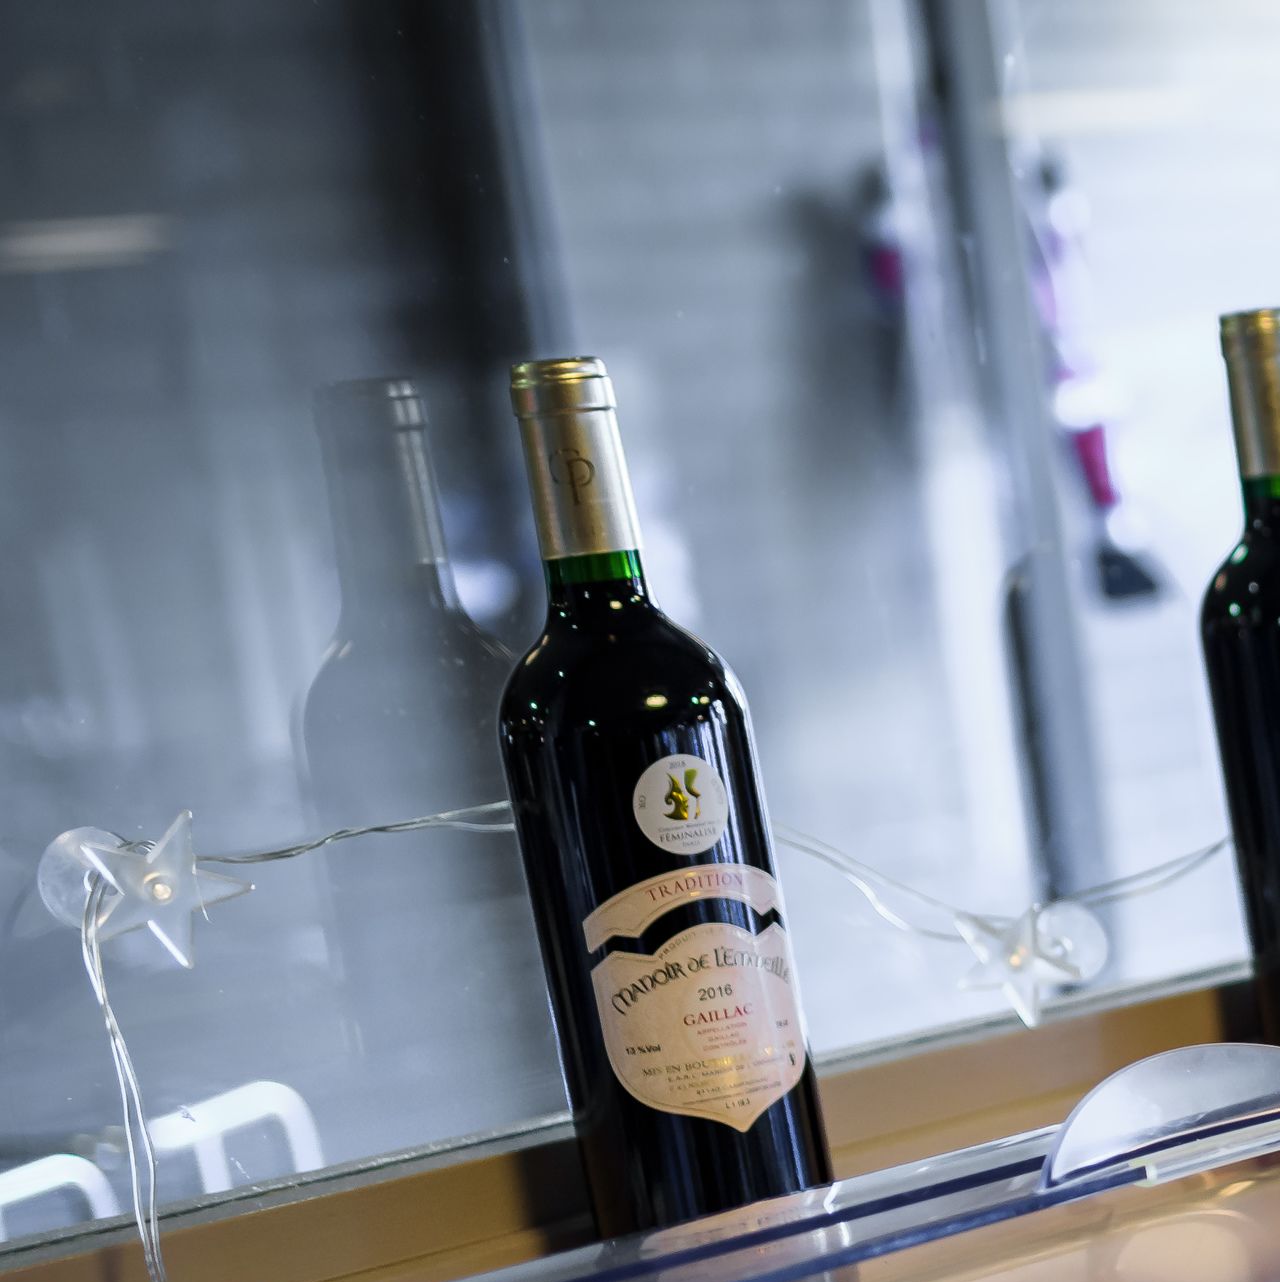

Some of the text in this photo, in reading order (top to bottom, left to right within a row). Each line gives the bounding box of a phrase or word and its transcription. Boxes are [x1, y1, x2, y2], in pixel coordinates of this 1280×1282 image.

[645, 871, 745, 902] TRADITION
[697, 983, 734, 1002] 2016
[683, 1003, 755, 1028] GAILLAC
